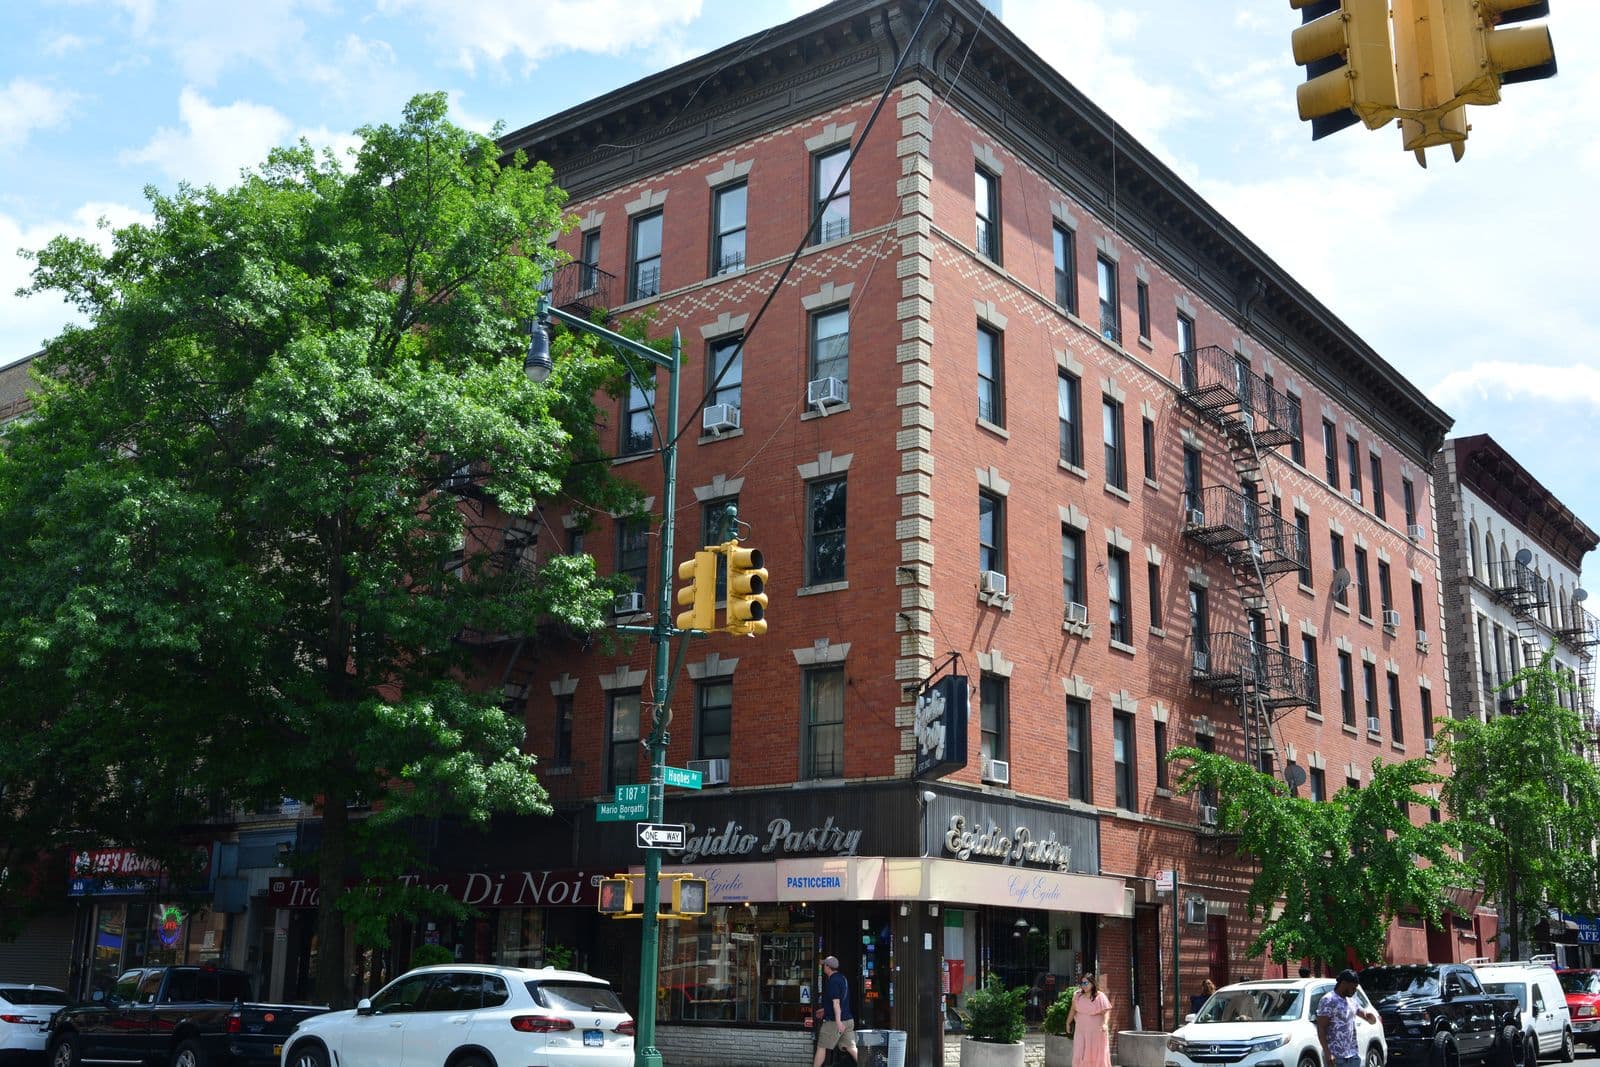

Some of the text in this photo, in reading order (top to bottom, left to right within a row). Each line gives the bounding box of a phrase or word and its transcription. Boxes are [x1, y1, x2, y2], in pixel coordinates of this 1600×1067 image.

[668, 769, 690, 785] Hughes
[618, 788, 624, 801] E
[626, 787, 639, 801] 187
[600, 804, 645, 816] Mario Borgatti
[645, 831, 680, 841] ONE WAY
[762, 816, 863, 856] Pastry
[945, 814, 1073, 873] Egidio Pastry
[463, 873, 508, 905] Di
[514, 871, 585, 905] Noi
[787, 876, 841, 889] PASTICCERIA
[801, 987, 810, 999] A
